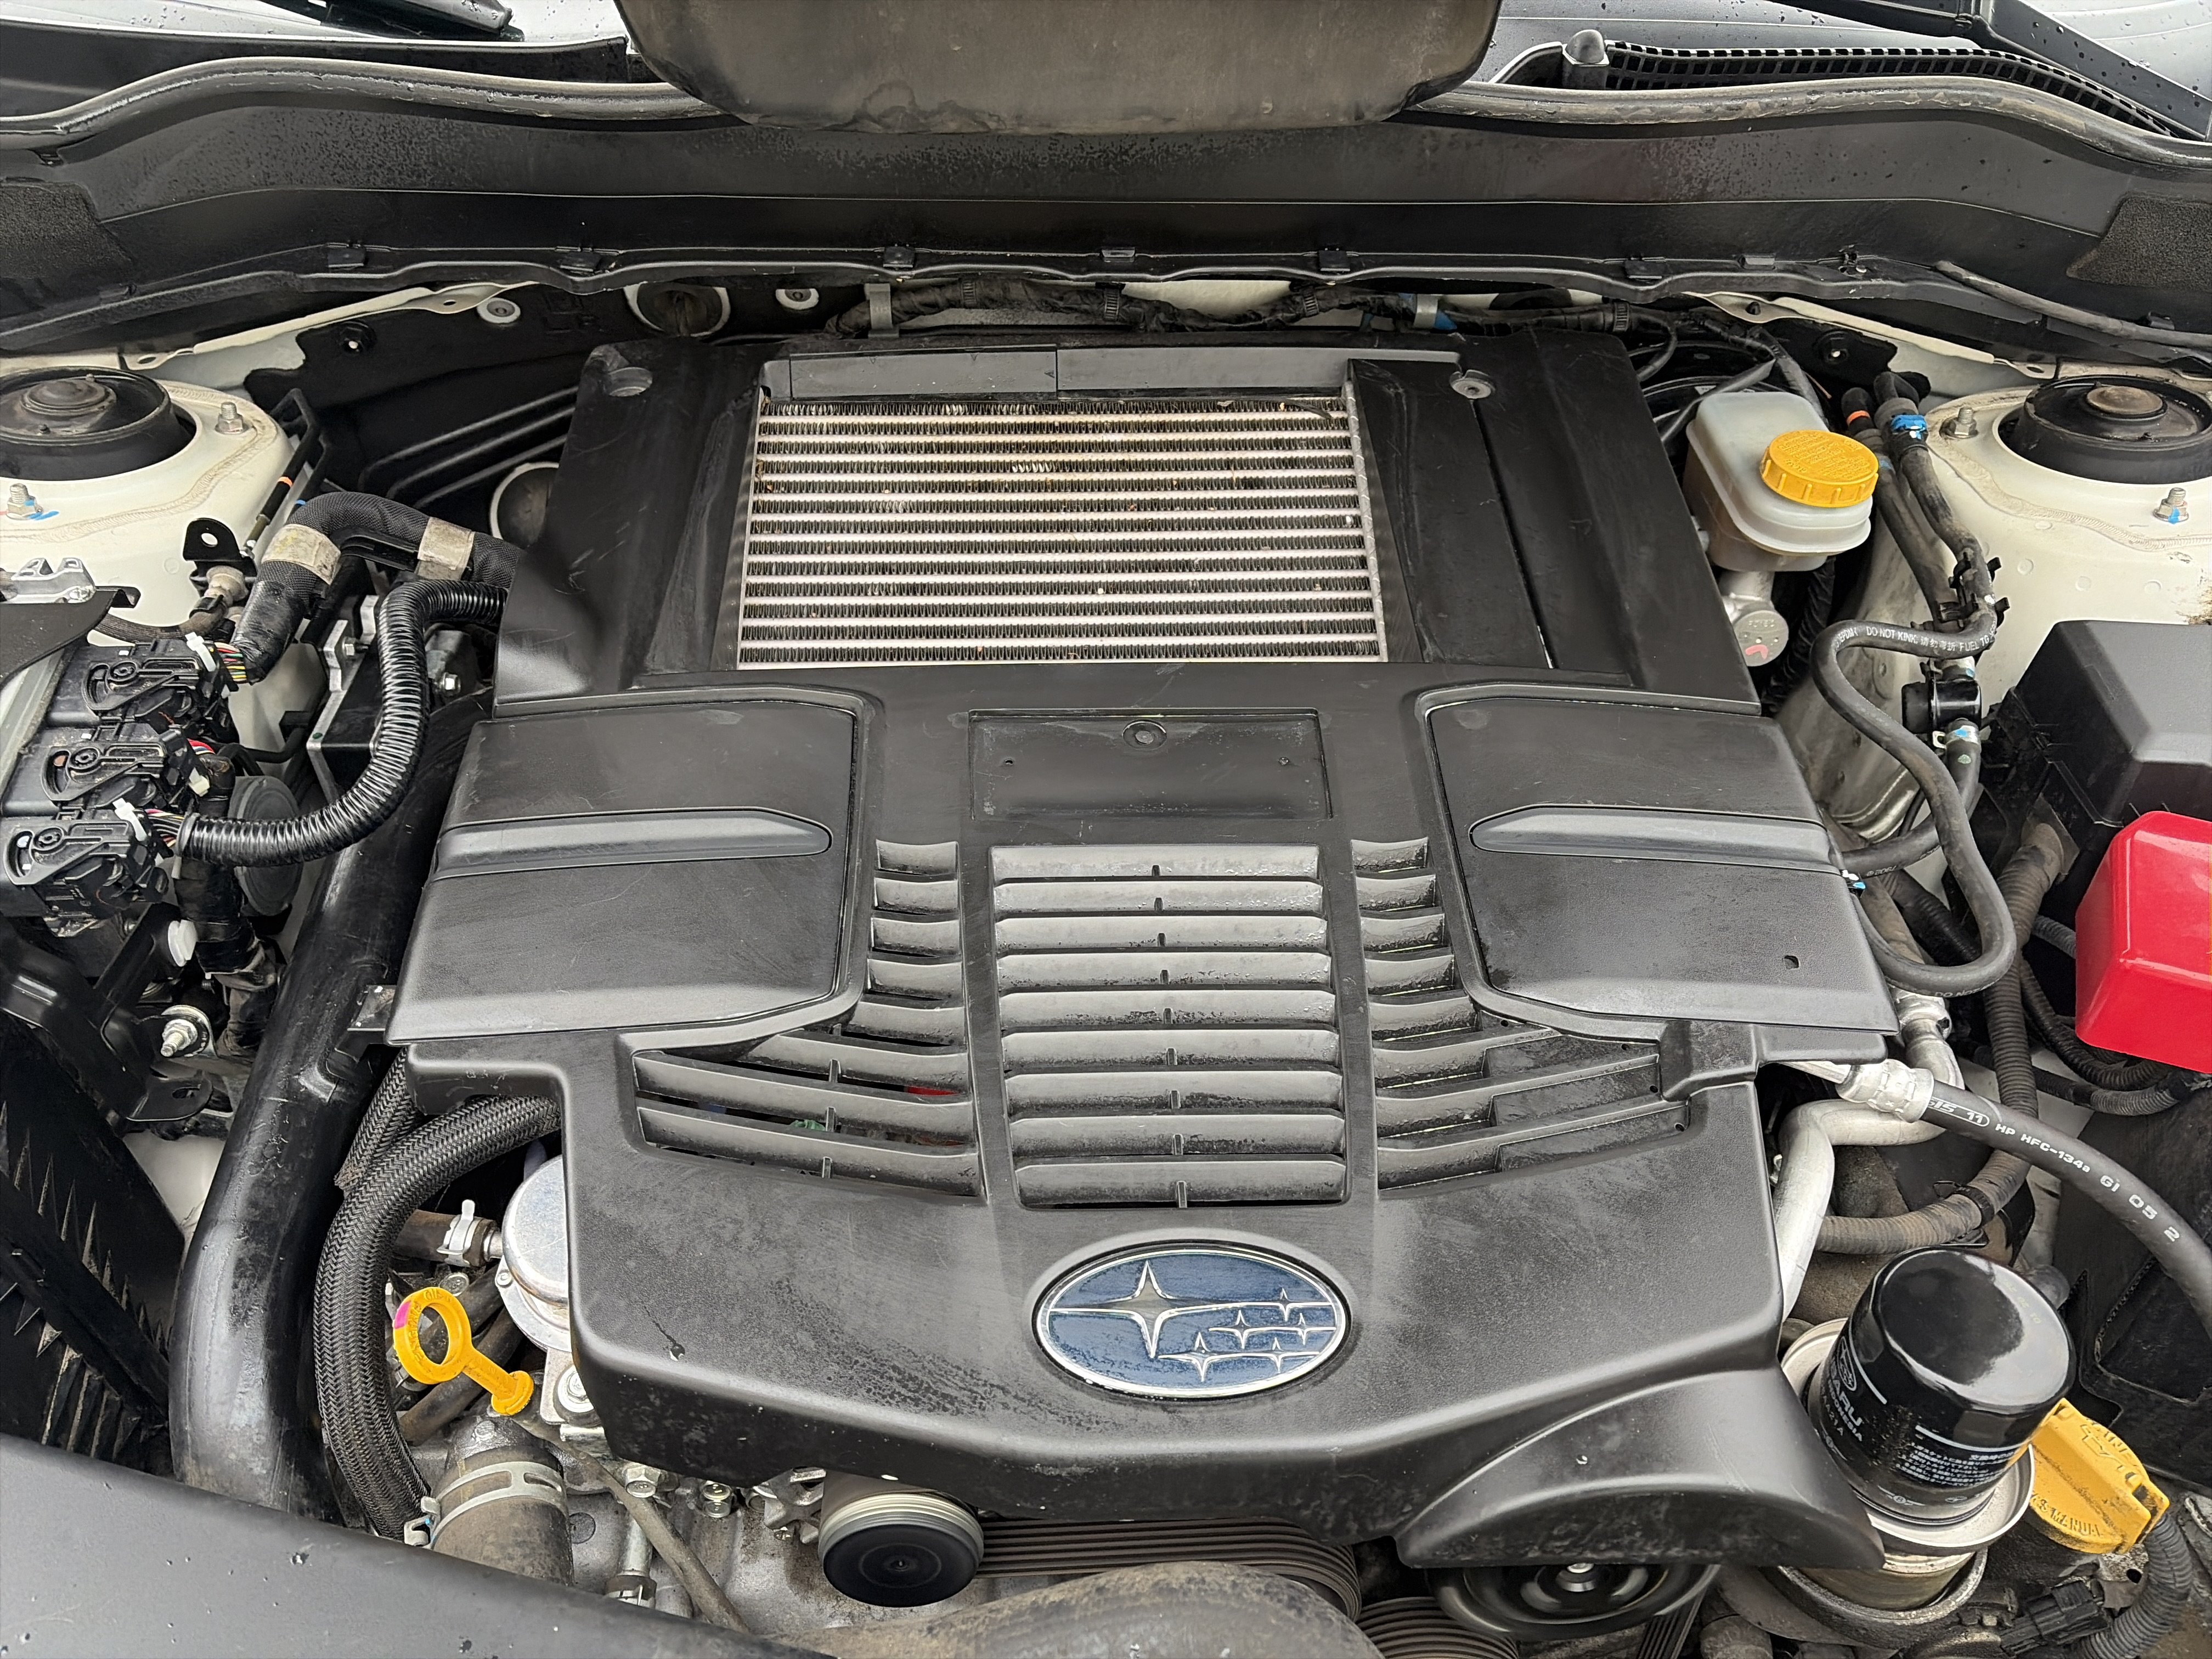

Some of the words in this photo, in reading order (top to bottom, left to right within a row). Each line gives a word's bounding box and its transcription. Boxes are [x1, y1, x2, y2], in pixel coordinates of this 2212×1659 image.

[1866, 626, 1878, 636] DO
[1878, 628, 1895, 639] NOT
[1959, 641, 1979, 652] FUEL
[1966, 1111, 1983, 1124] 11
[1995, 1123, 2016, 1136] HP
[2021, 1133, 2091, 1173] HFC-134a
[2163, 1226, 2180, 1242] 2
